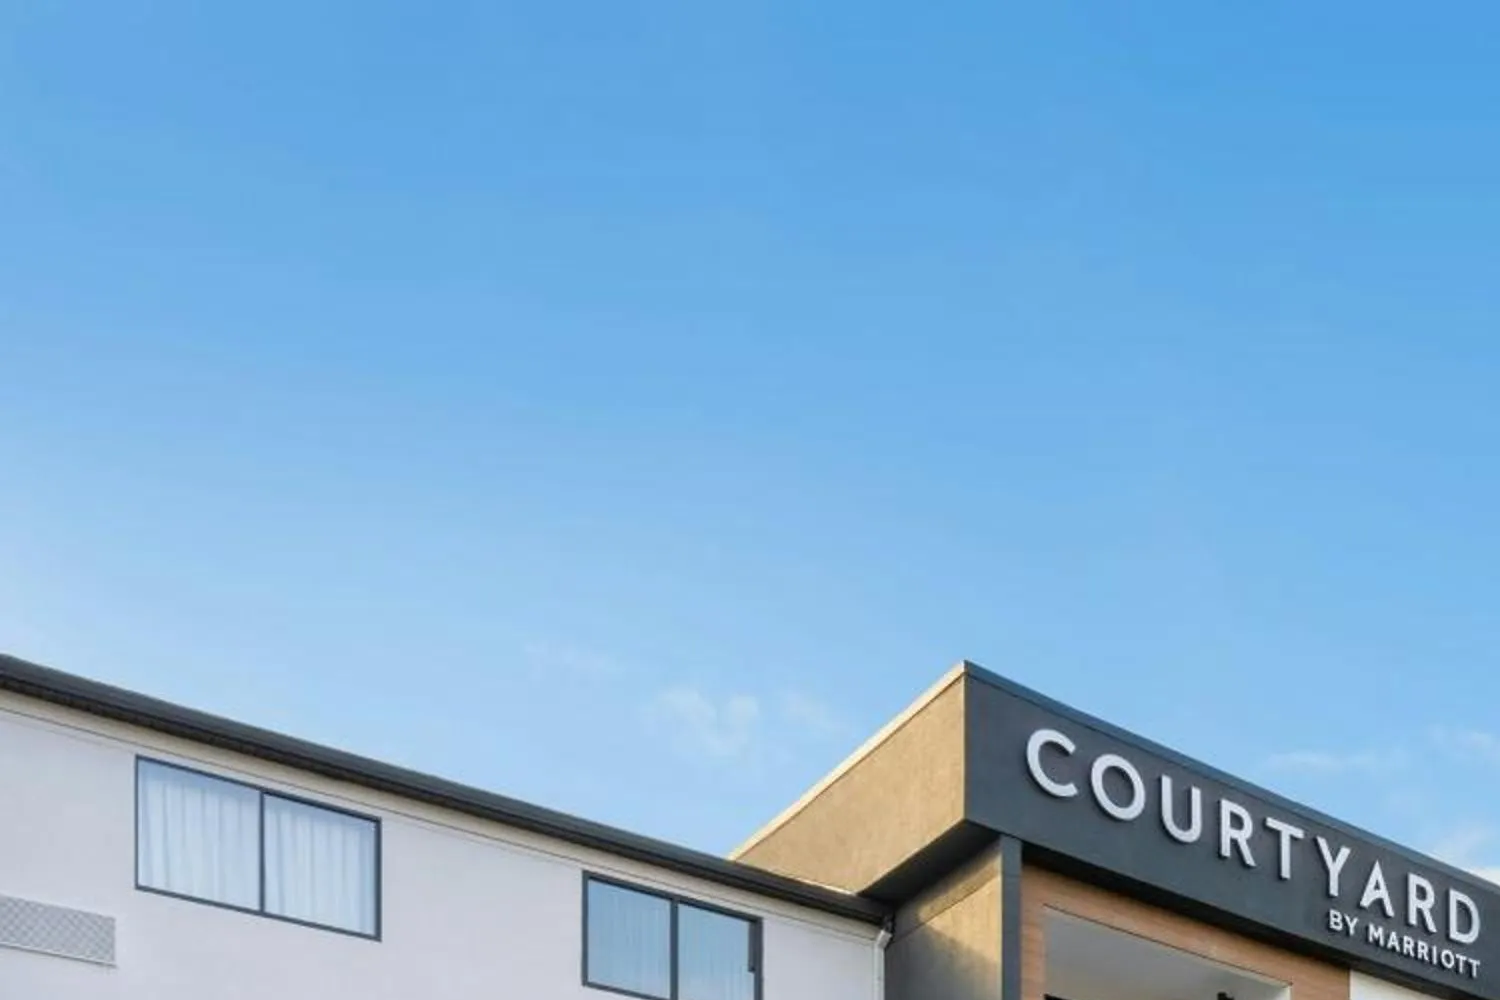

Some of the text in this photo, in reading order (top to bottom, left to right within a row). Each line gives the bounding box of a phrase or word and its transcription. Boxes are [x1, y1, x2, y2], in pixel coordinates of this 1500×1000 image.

[1025, 728, 1481, 945] COURTYARD
[1328, 908, 1481, 978] BY MARRIOTT
